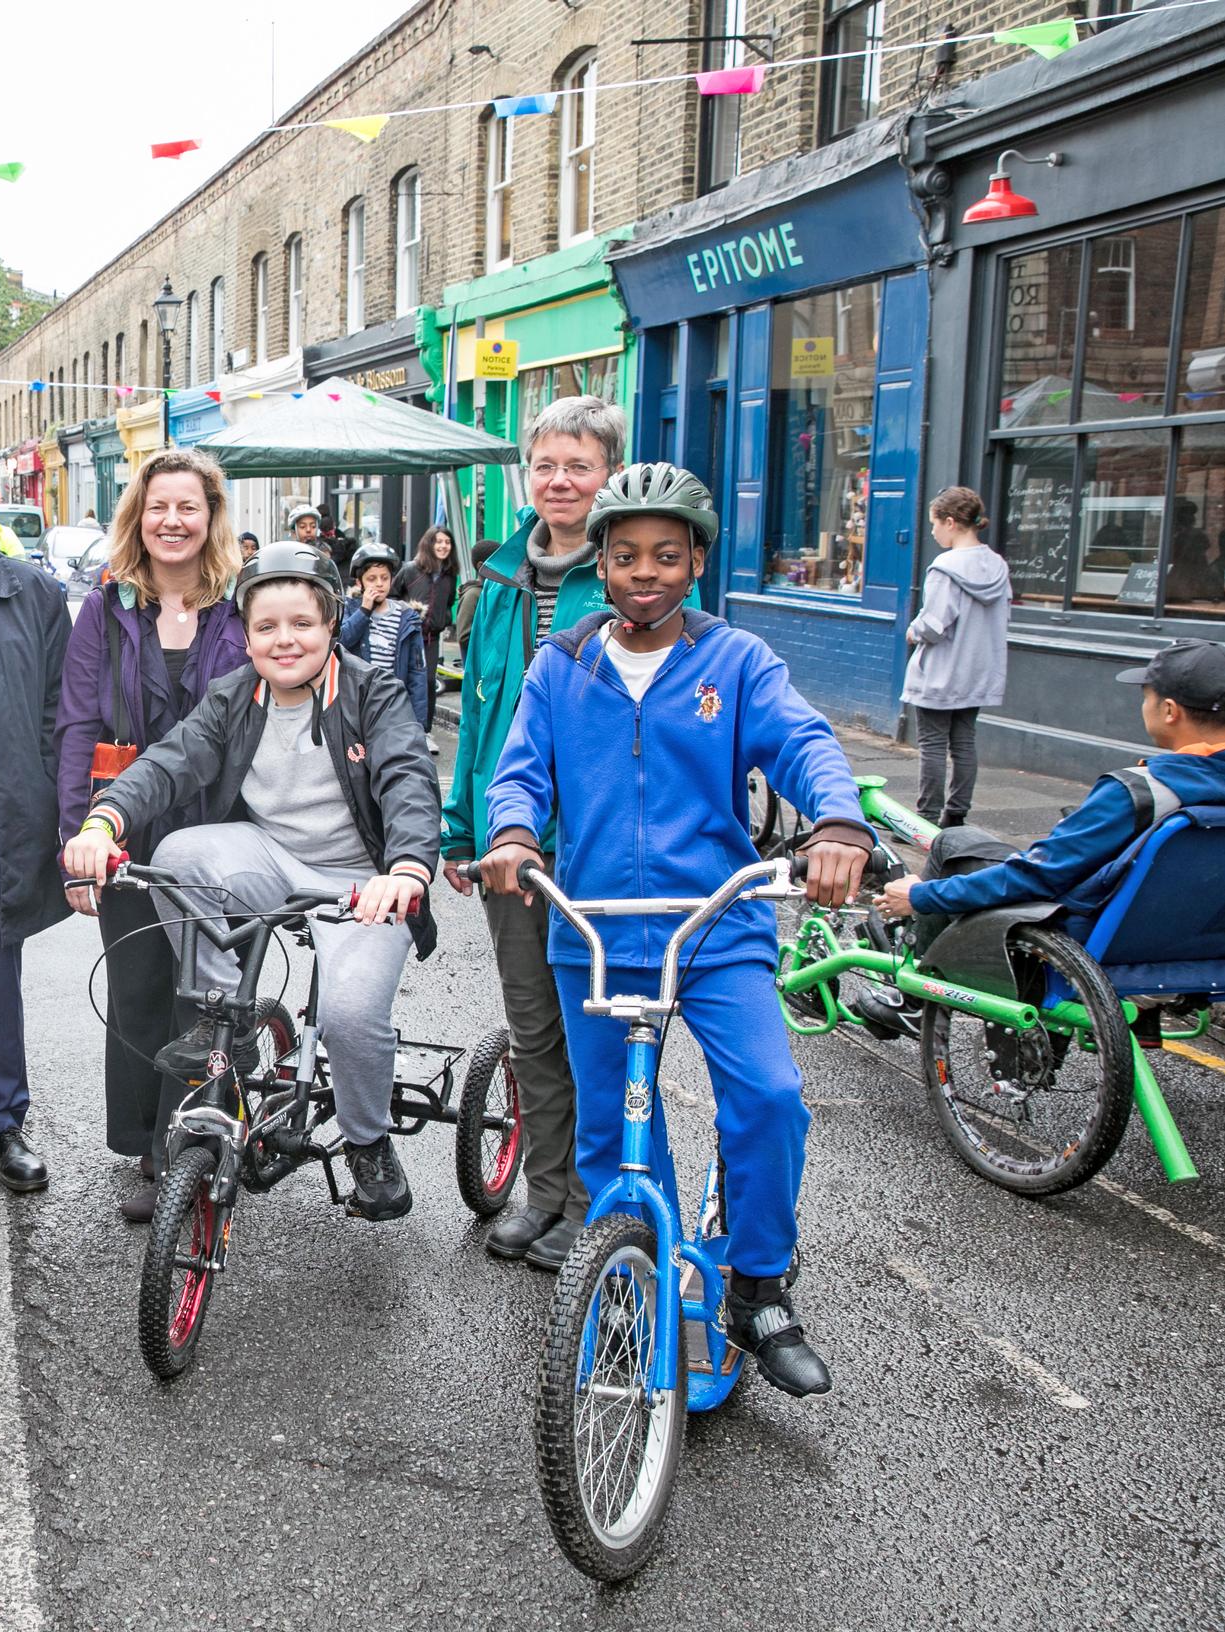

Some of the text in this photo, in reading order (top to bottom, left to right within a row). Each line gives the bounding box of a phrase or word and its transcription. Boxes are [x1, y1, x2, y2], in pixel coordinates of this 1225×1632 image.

[686, 221, 805, 293] EPITOME
[482, 355, 511, 364] NOTICE
[365, 366, 407, 391] Blossom
